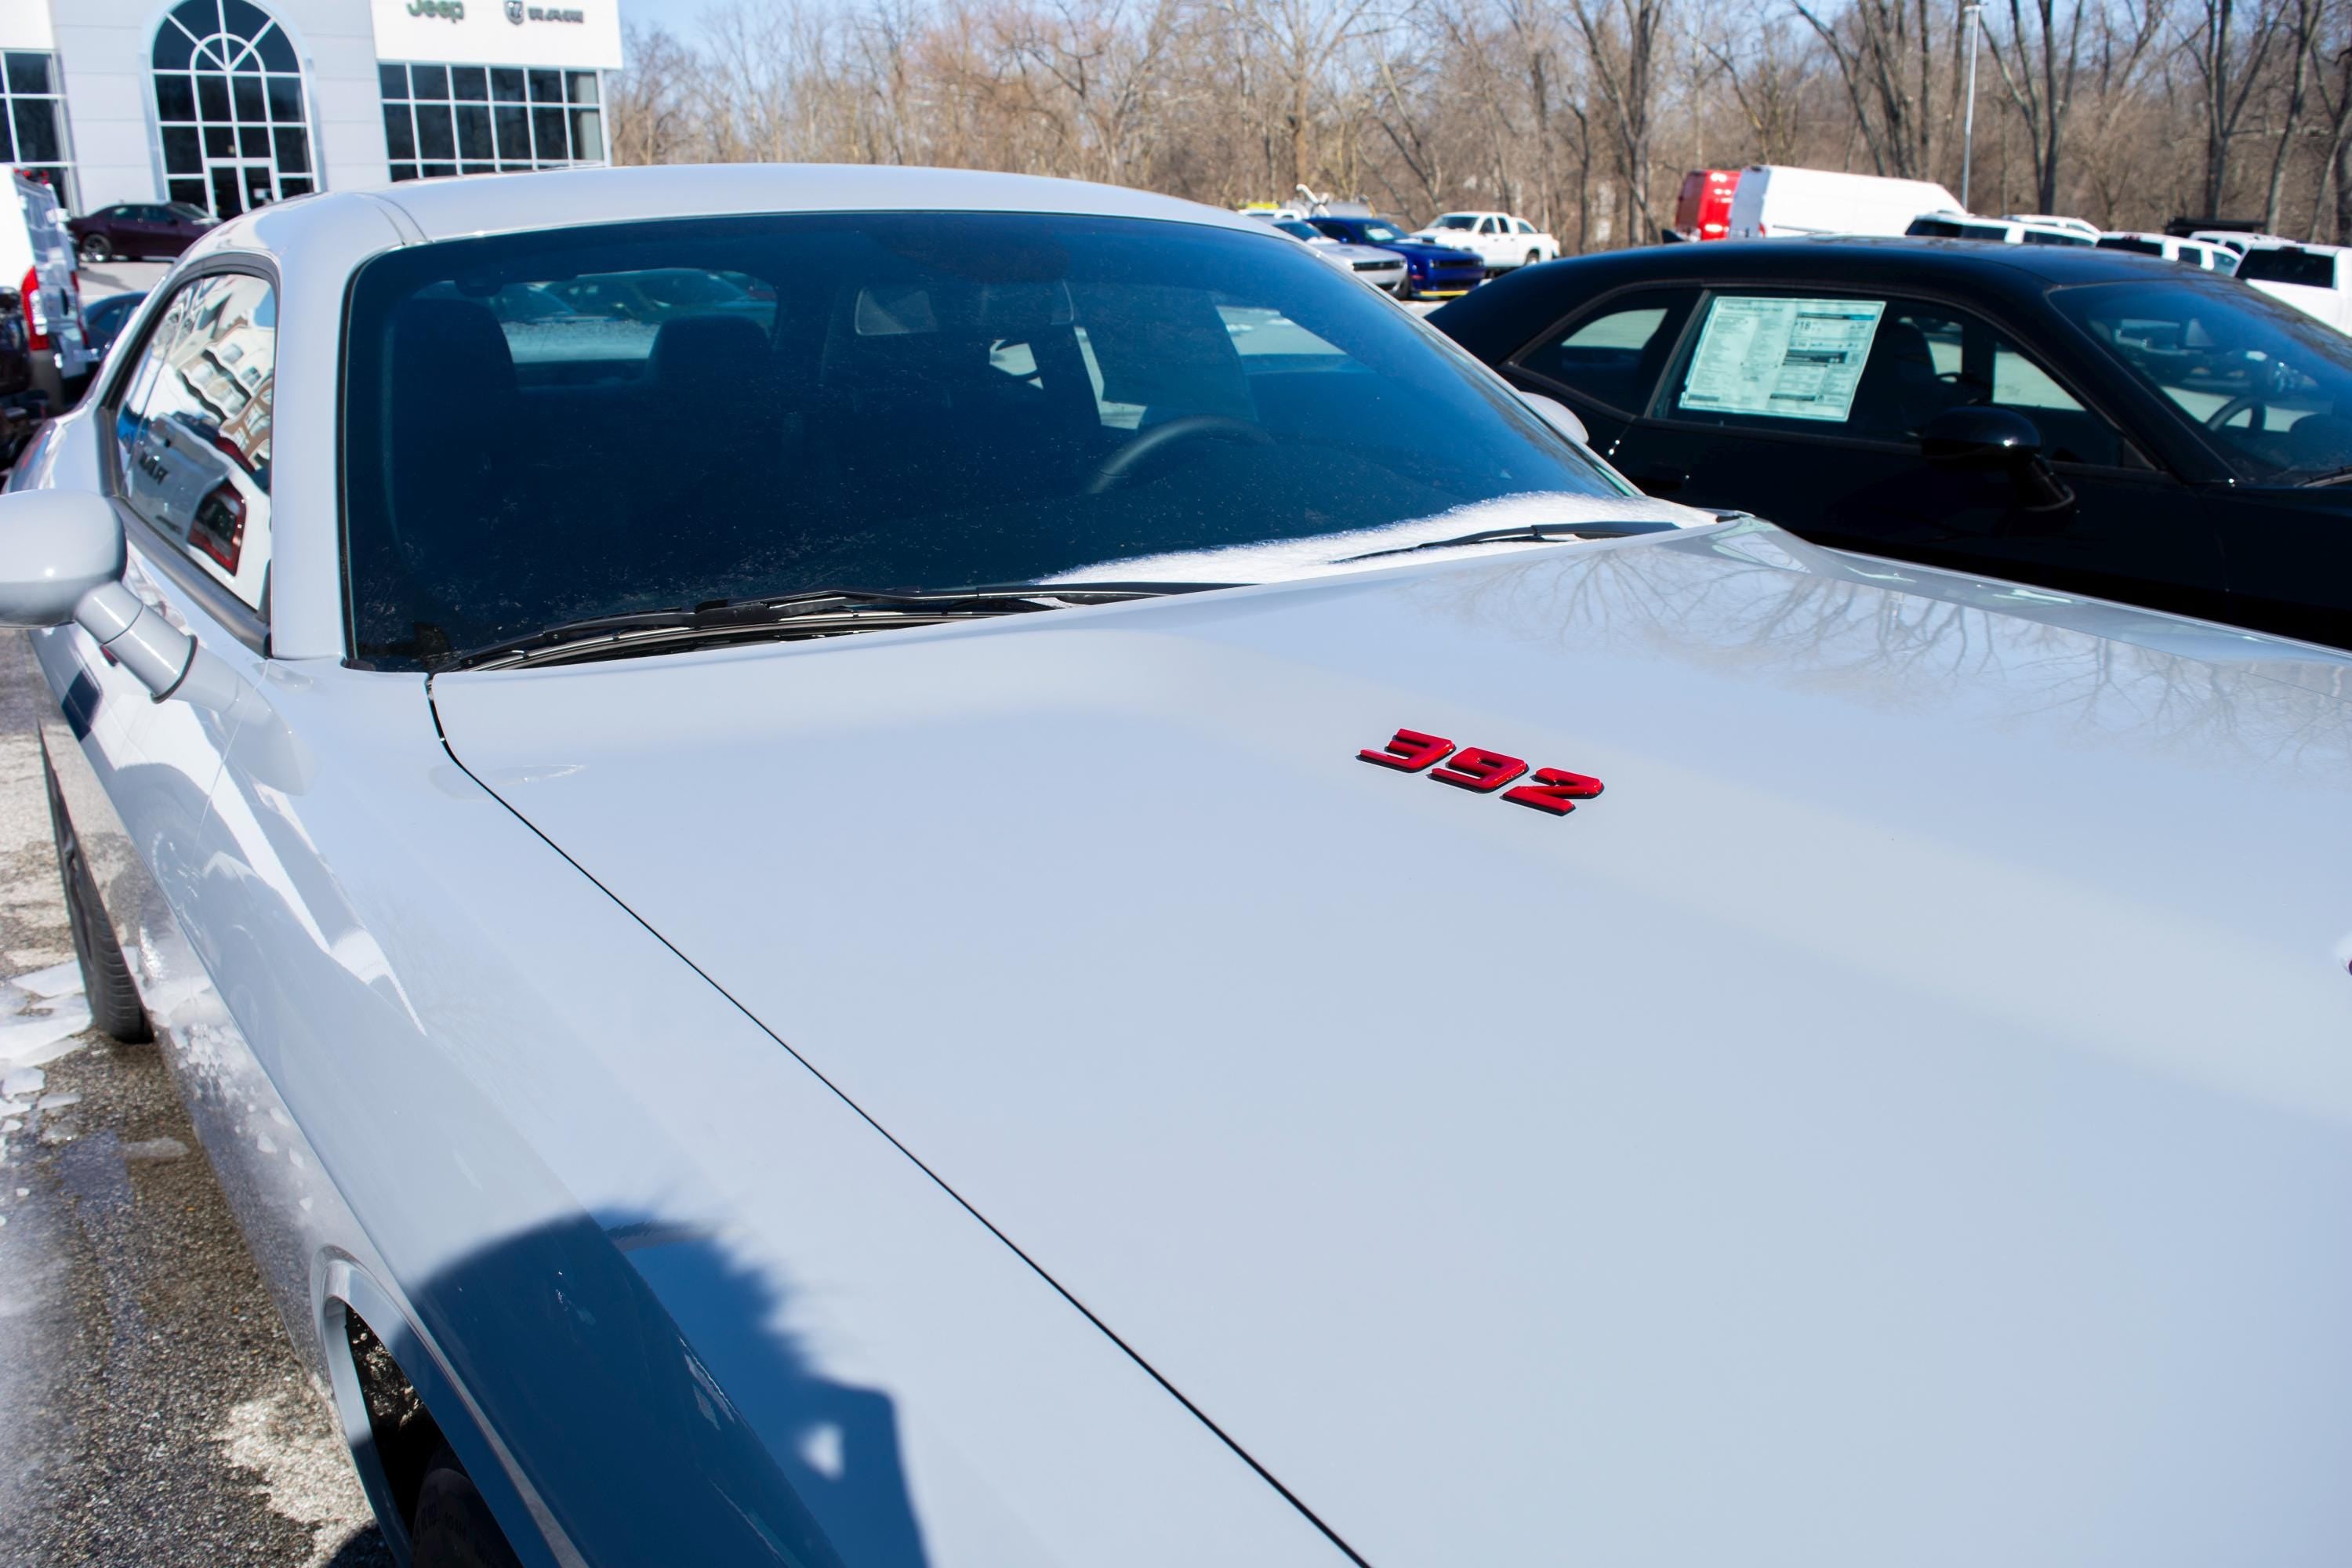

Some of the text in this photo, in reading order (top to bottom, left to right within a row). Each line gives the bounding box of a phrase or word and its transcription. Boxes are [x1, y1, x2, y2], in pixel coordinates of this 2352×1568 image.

[406, 0, 464, 24] Jeep
[528, 8, 583, 24] RAM
[1356, 728, 1604, 816] 392
